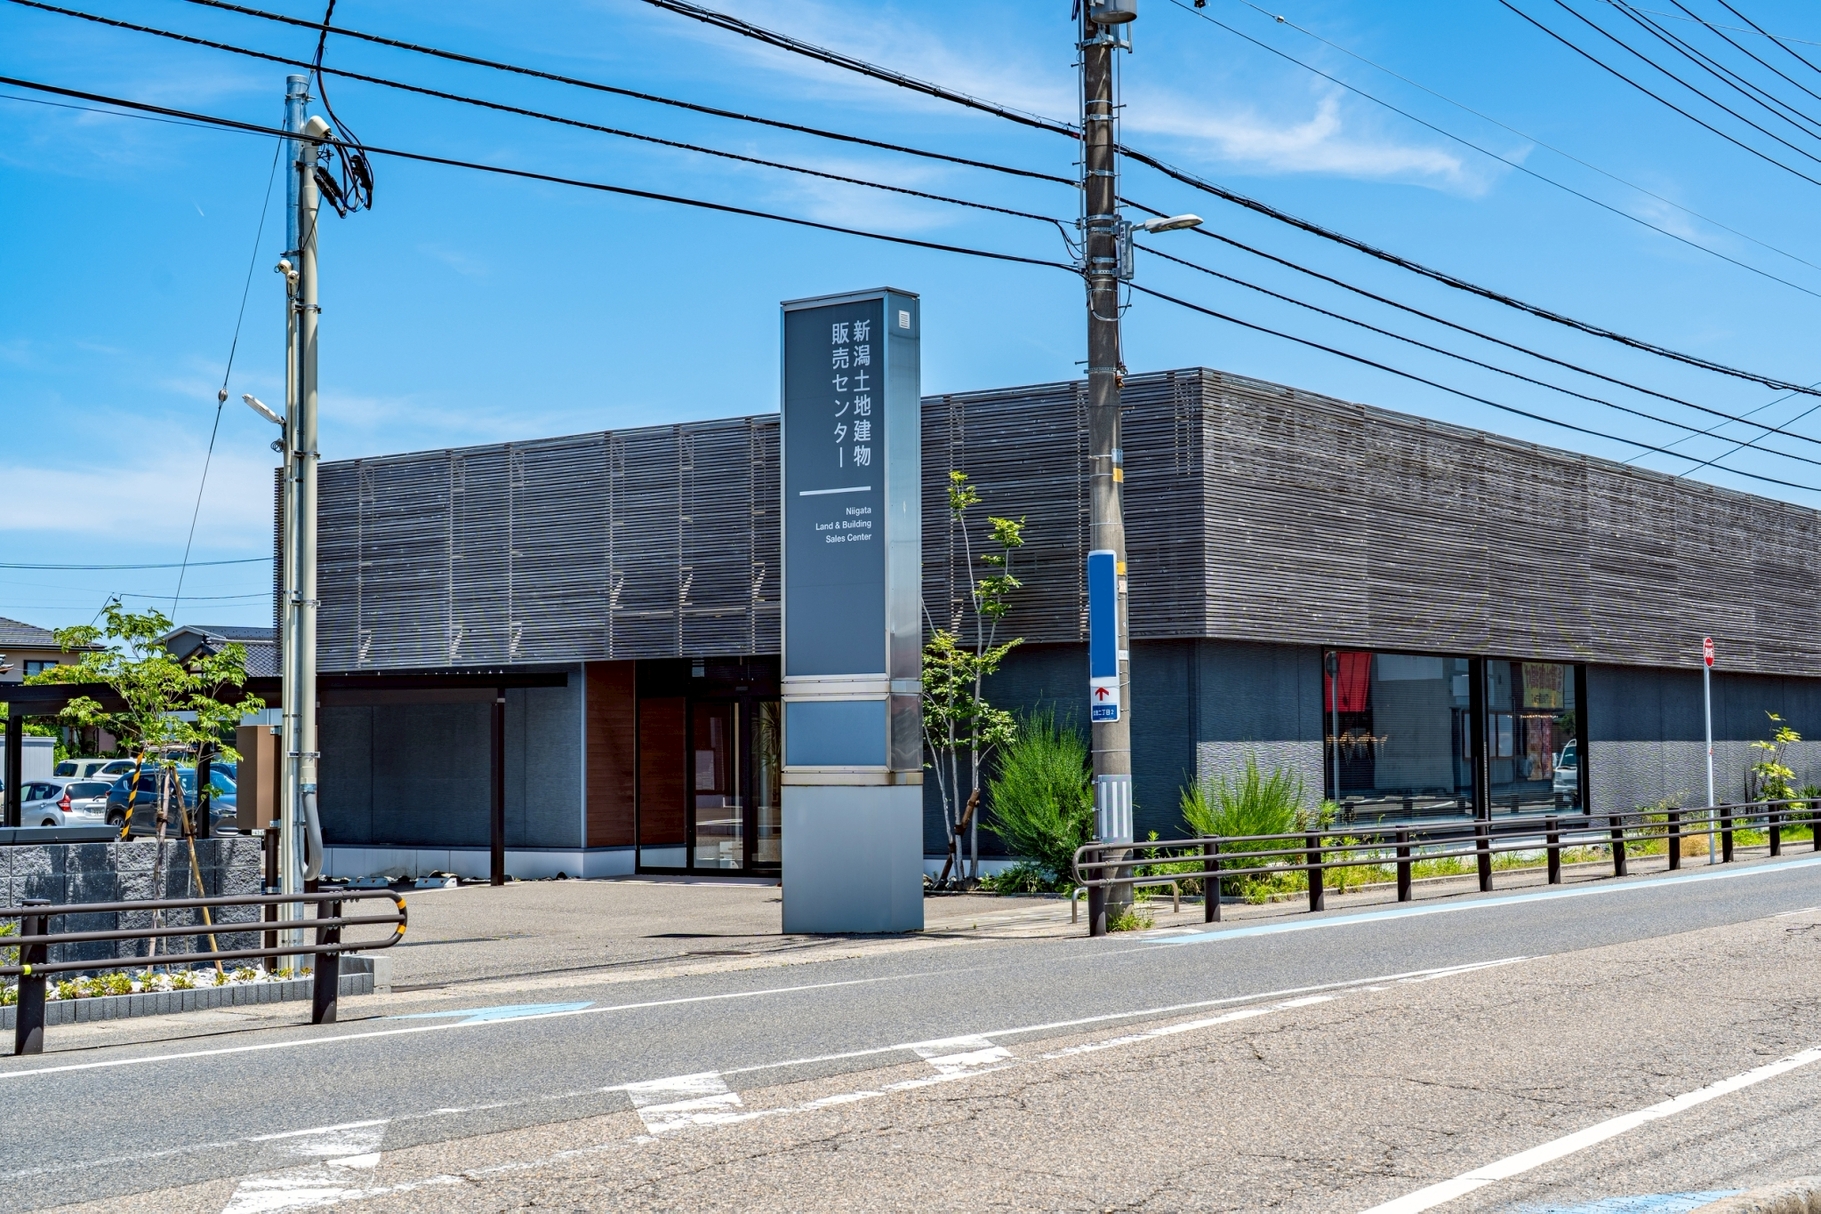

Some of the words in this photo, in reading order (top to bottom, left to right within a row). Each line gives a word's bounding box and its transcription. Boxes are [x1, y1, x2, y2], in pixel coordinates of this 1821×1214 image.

[832, 322, 849, 468] 販売センター
[853, 319, 871, 467] 新潟土地建物
[845, 506, 872, 517] Niigata
[815, 522, 834, 531] Land
[834, 521, 841, 530] &
[842, 519, 872, 529] Building
[825, 534, 846, 544] Sales
[846, 533, 872, 542] Center
